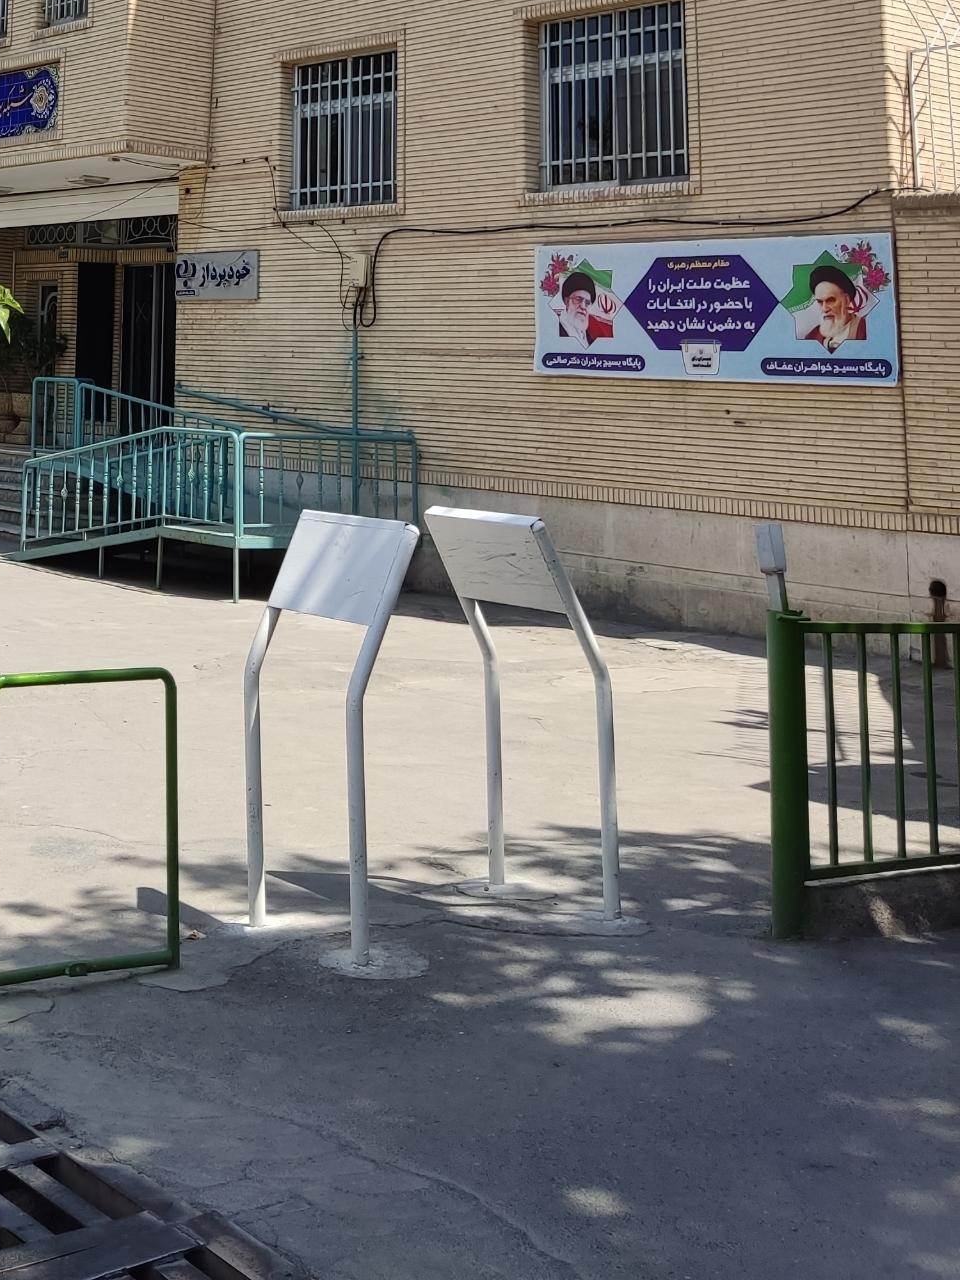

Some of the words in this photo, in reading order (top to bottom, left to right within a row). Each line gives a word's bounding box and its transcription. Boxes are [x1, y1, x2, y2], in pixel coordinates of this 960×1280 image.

[667, 261, 689, 271] رهبری
[689, 260, 712, 269] معظم
[713, 259, 730, 270] مقام
[199, 259, 251, 288] خودپرداز
[648, 278, 657, 294] را
[657, 278, 685, 294] ایران
[686, 277, 712, 290] ملت
[713, 277, 751, 291] عظمت
[646, 297, 696, 313] انتخابات
[696, 300, 708, 313] در
[708, 298, 743, 313] حضور
[743, 297, 753, 312] با
[646, 319, 676, 333] دهید
[676, 317, 706, 333] نشان
[707, 317, 742, 333] دشمن
[743, 320, 756, 333] به
[546, 356, 567, 366] صالحی
[566, 356, 581, 366] دکتر
[581, 357, 602, 368] برادران
[602, 358, 622, 368] بسیج
[622, 358, 642, 370] پایگاه
[766, 360, 793, 371] عفاف
[794, 361, 833, 373] خواهران
[833, 363, 859, 374] بسیج
[860, 361, 886, 376] پایگاه
